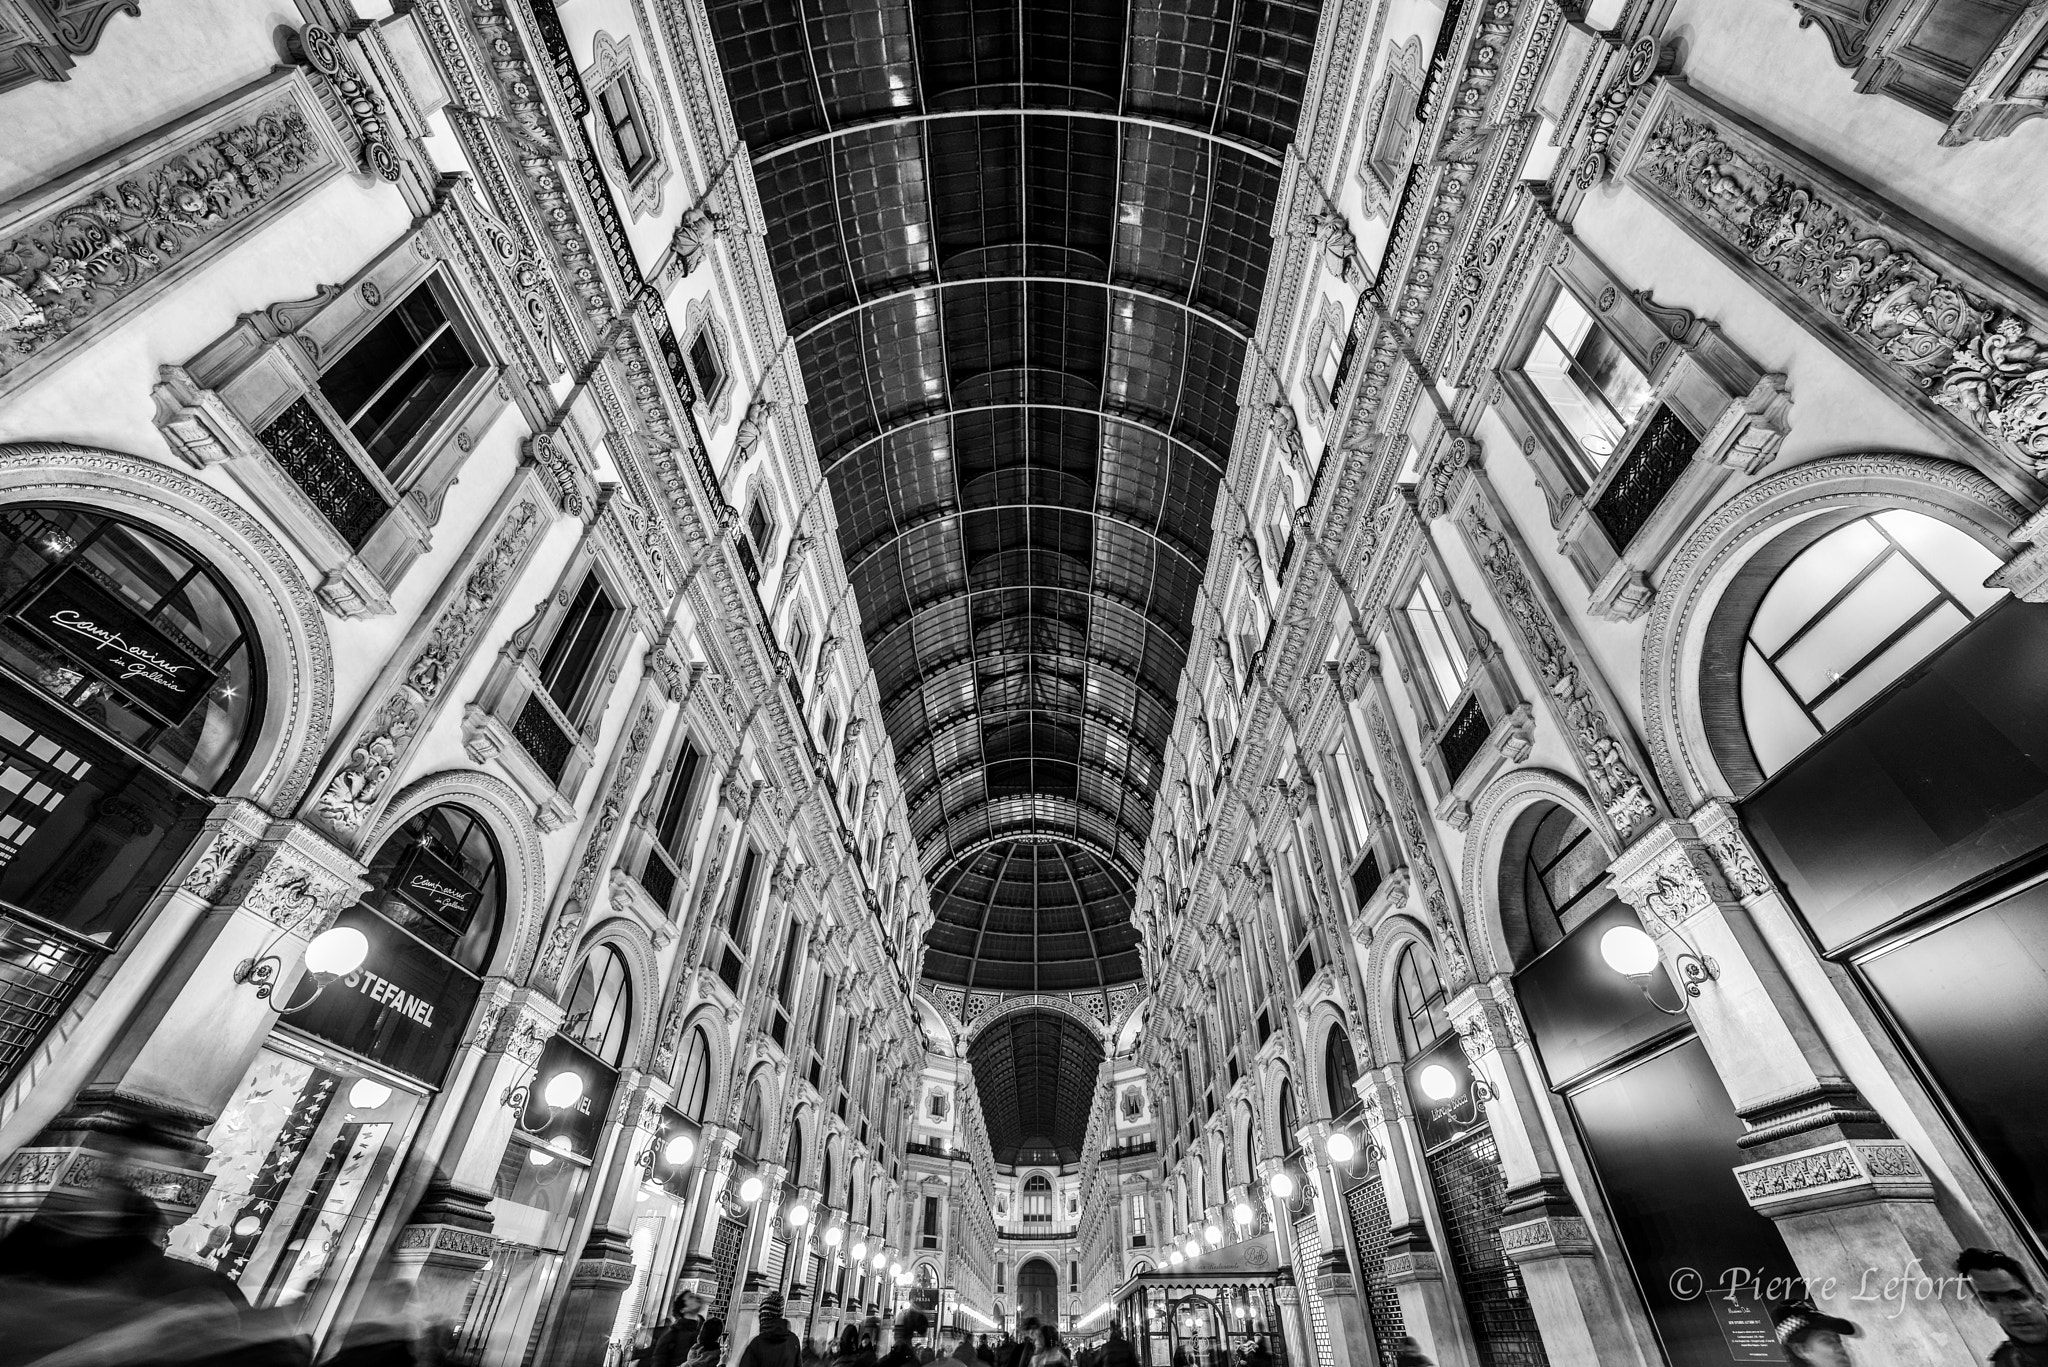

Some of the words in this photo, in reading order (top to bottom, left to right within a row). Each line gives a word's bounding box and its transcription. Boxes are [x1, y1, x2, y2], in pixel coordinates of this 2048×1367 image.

[50, 610, 195, 673] Camparino
[109, 656, 125, 667] in
[120, 663, 186, 692] Galleria
[410, 875, 472, 899] Camparino
[439, 898, 468, 912] Galleria
[344, 966, 434, 1028] STEFANEL
